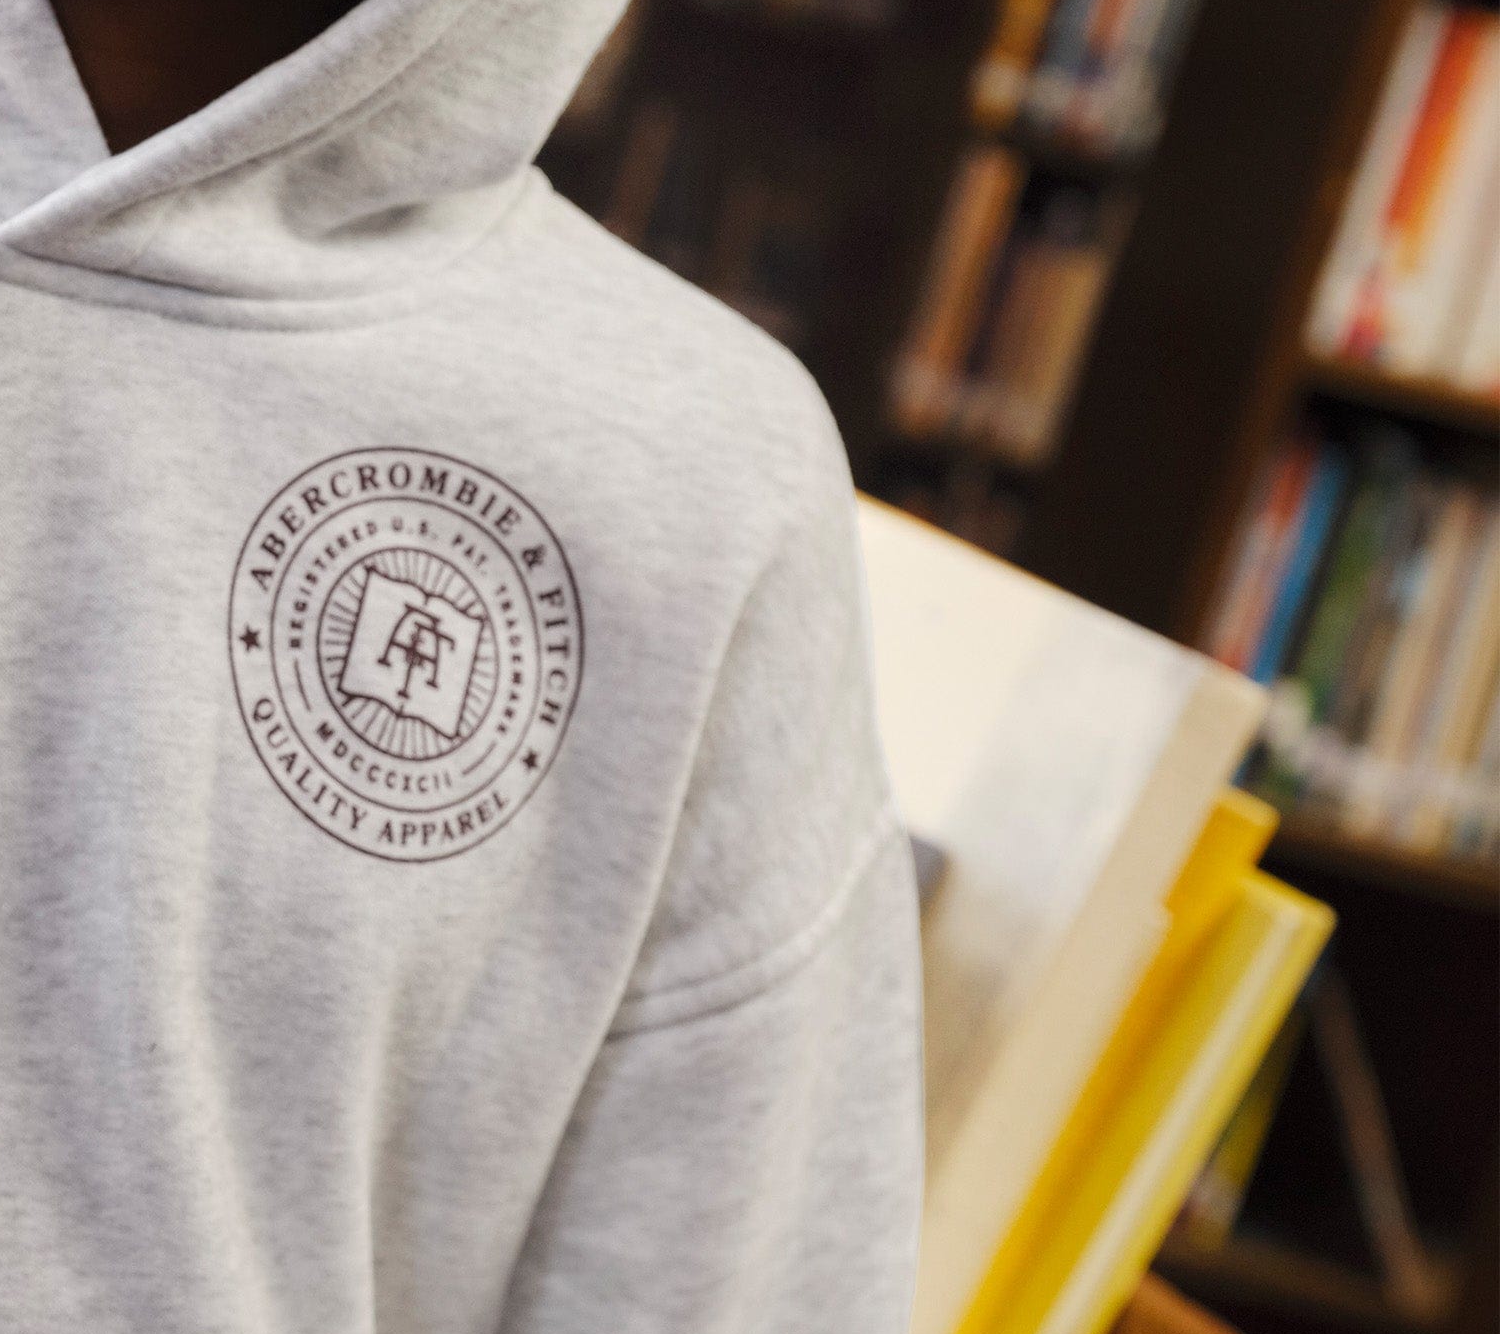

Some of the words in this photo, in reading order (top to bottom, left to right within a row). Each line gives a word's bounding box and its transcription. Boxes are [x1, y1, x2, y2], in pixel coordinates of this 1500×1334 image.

[250, 462, 522, 592] ABERCROMBIE
[521, 544, 545, 571] &
[538, 588, 571, 726] FITCH
[290, 520, 378, 648] REGISTERED
[253, 697, 368, 830] QUALITY
[378, 790, 508, 845] APPAREL
